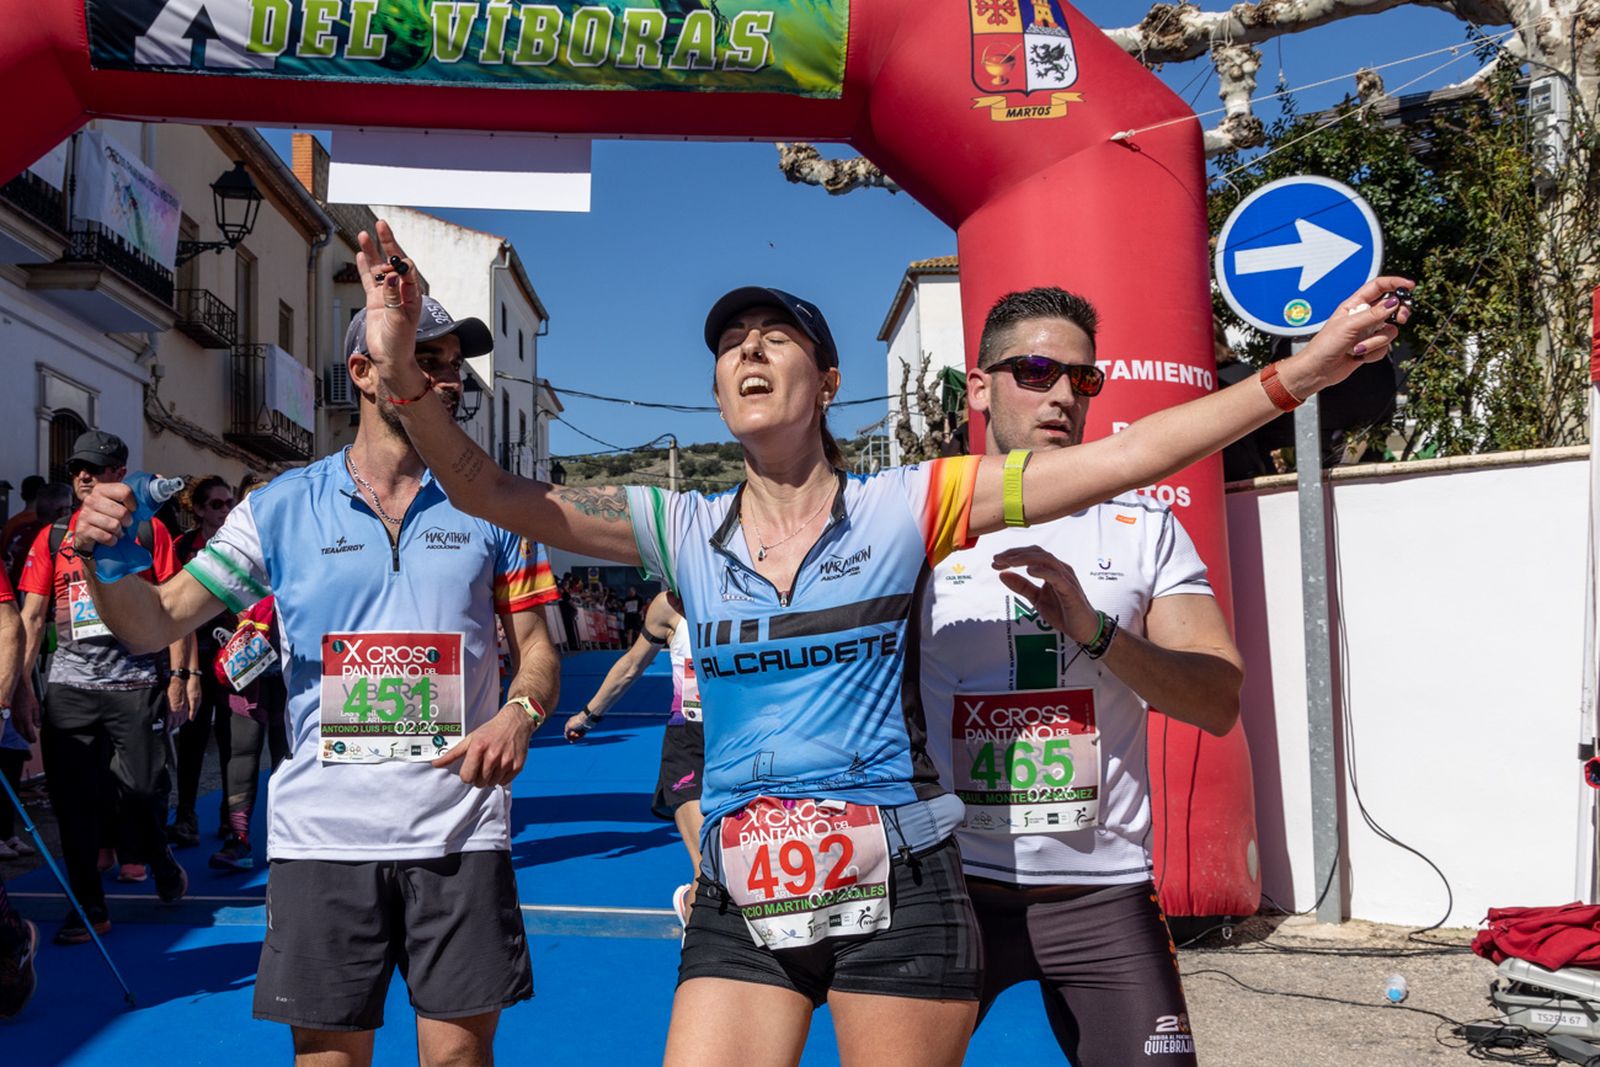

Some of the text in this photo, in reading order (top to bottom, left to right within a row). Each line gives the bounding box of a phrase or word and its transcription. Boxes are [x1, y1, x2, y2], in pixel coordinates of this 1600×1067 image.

[246, 0, 387, 60] DEL
[1006, 106, 1051, 118] MARTOS
[426, 531, 471, 545] MARATHON
[820, 545, 871, 574] MARATHON
[227, 637, 263, 677] 2502
[343, 639, 363, 663] X
[701, 632, 897, 680] ALCAUDETE
[342, 664, 421, 680] PANTANO
[343, 677, 430, 723] 451
[964, 701, 1070, 727] X CROSS
[321, 725, 358, 733] ANTONIO
[361, 724, 380, 733] LUIS
[965, 725, 1054, 744] PANTANO
[970, 739, 1074, 789] 465
[765, 802, 846, 827] CRO
[739, 820, 831, 851] PANTANO
[747, 834, 857, 899] 492
[1569, 1016, 1581, 1025] 67
